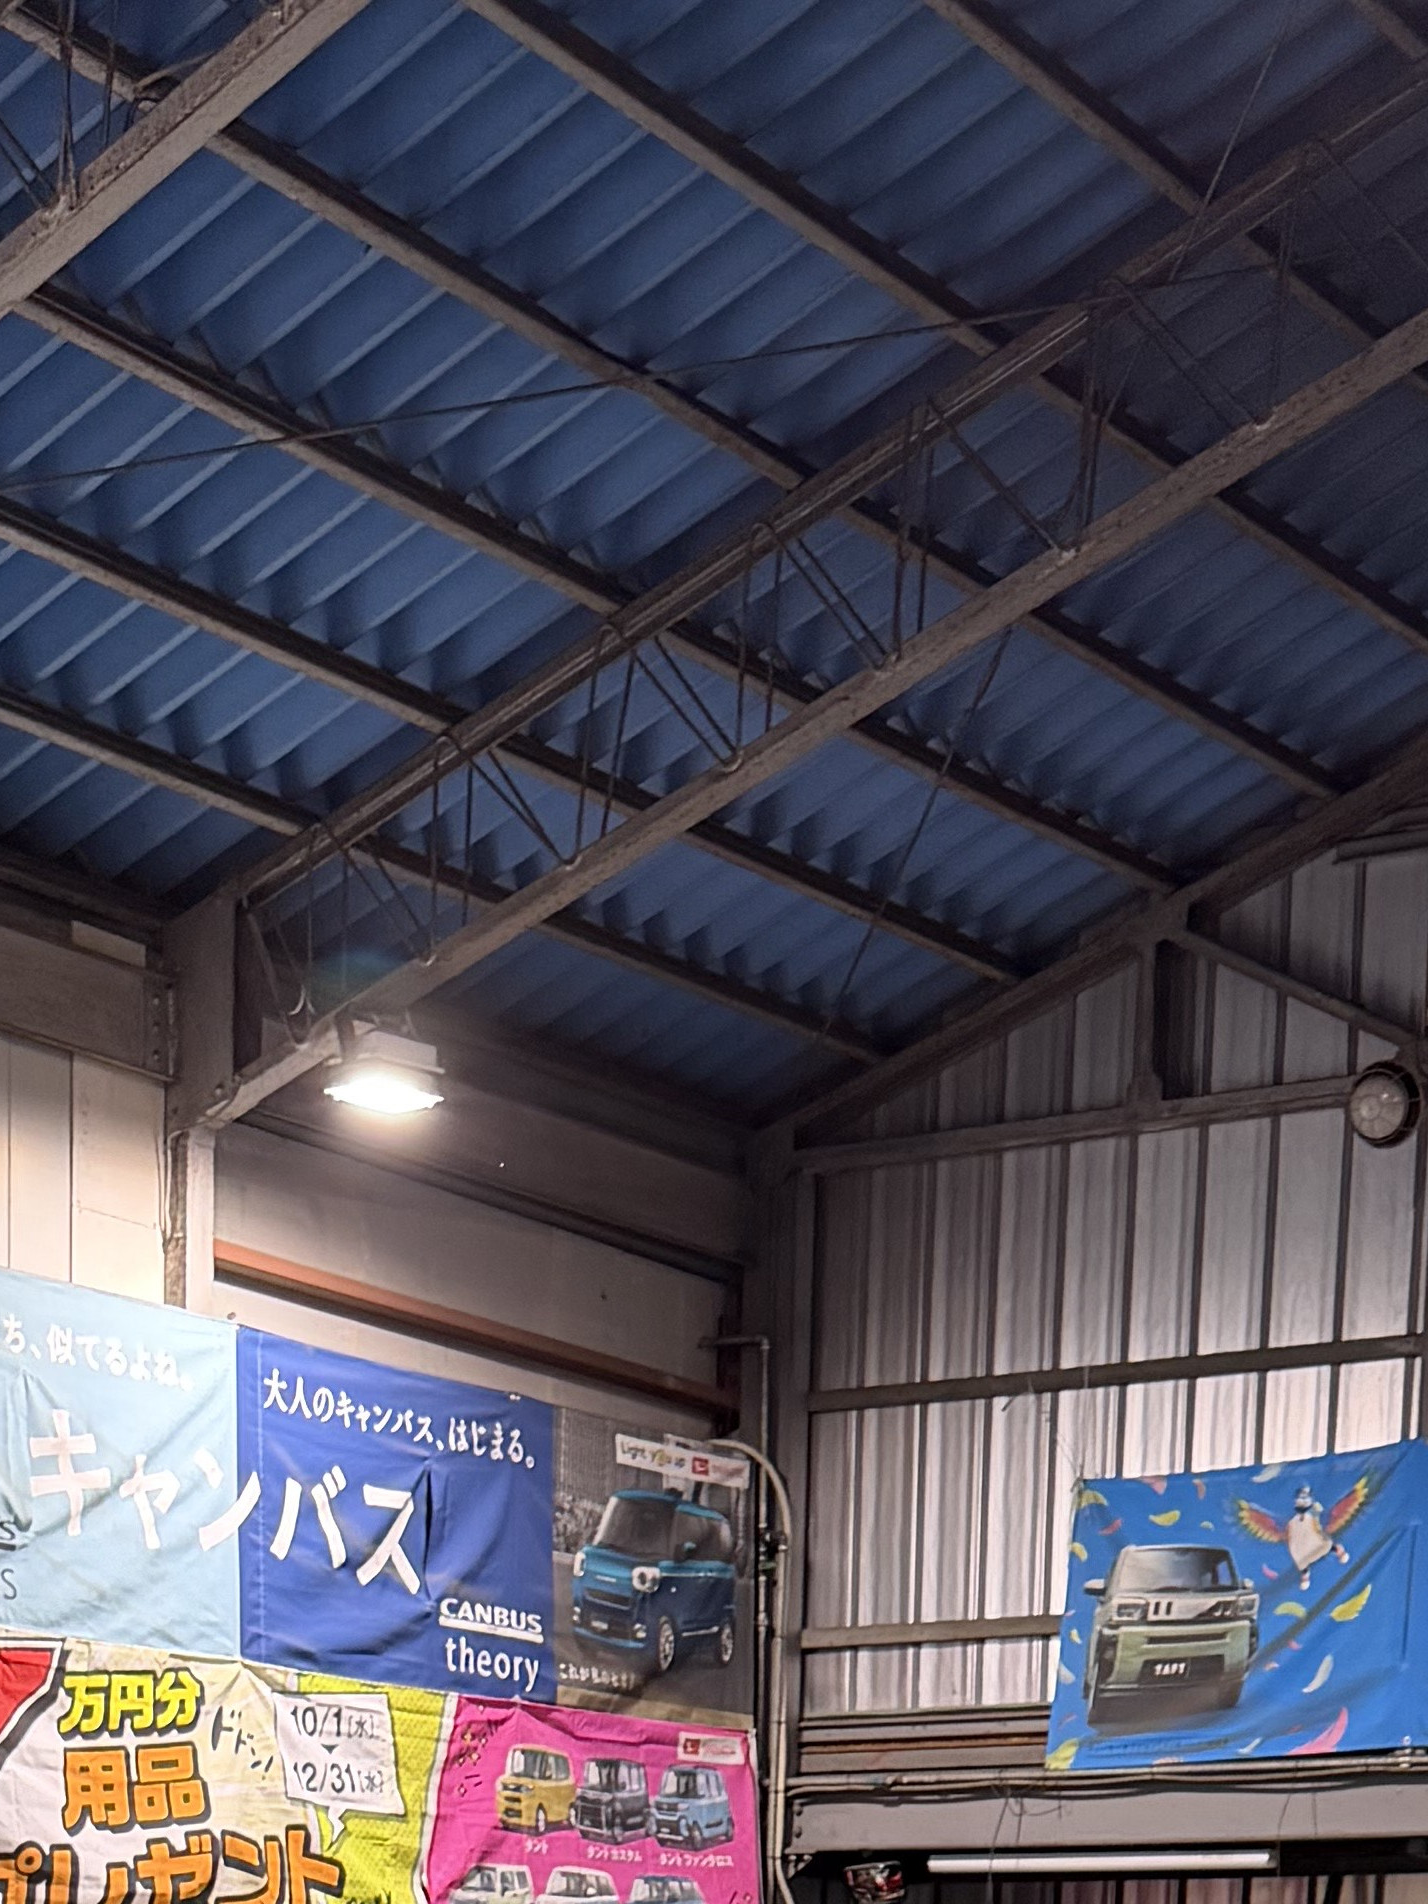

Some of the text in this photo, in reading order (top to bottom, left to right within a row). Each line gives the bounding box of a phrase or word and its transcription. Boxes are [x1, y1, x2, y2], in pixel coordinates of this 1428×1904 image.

[262, 1368, 536, 1469] 大人のキャンバス、はじまる。
[29, 1408, 421, 1596] キャンバス
[439, 1597, 543, 1634] CANBUS
[445, 1636, 539, 1691] theory
[60, 1672, 203, 1735] 万円分
[63, 1743, 210, 1831] 用品
